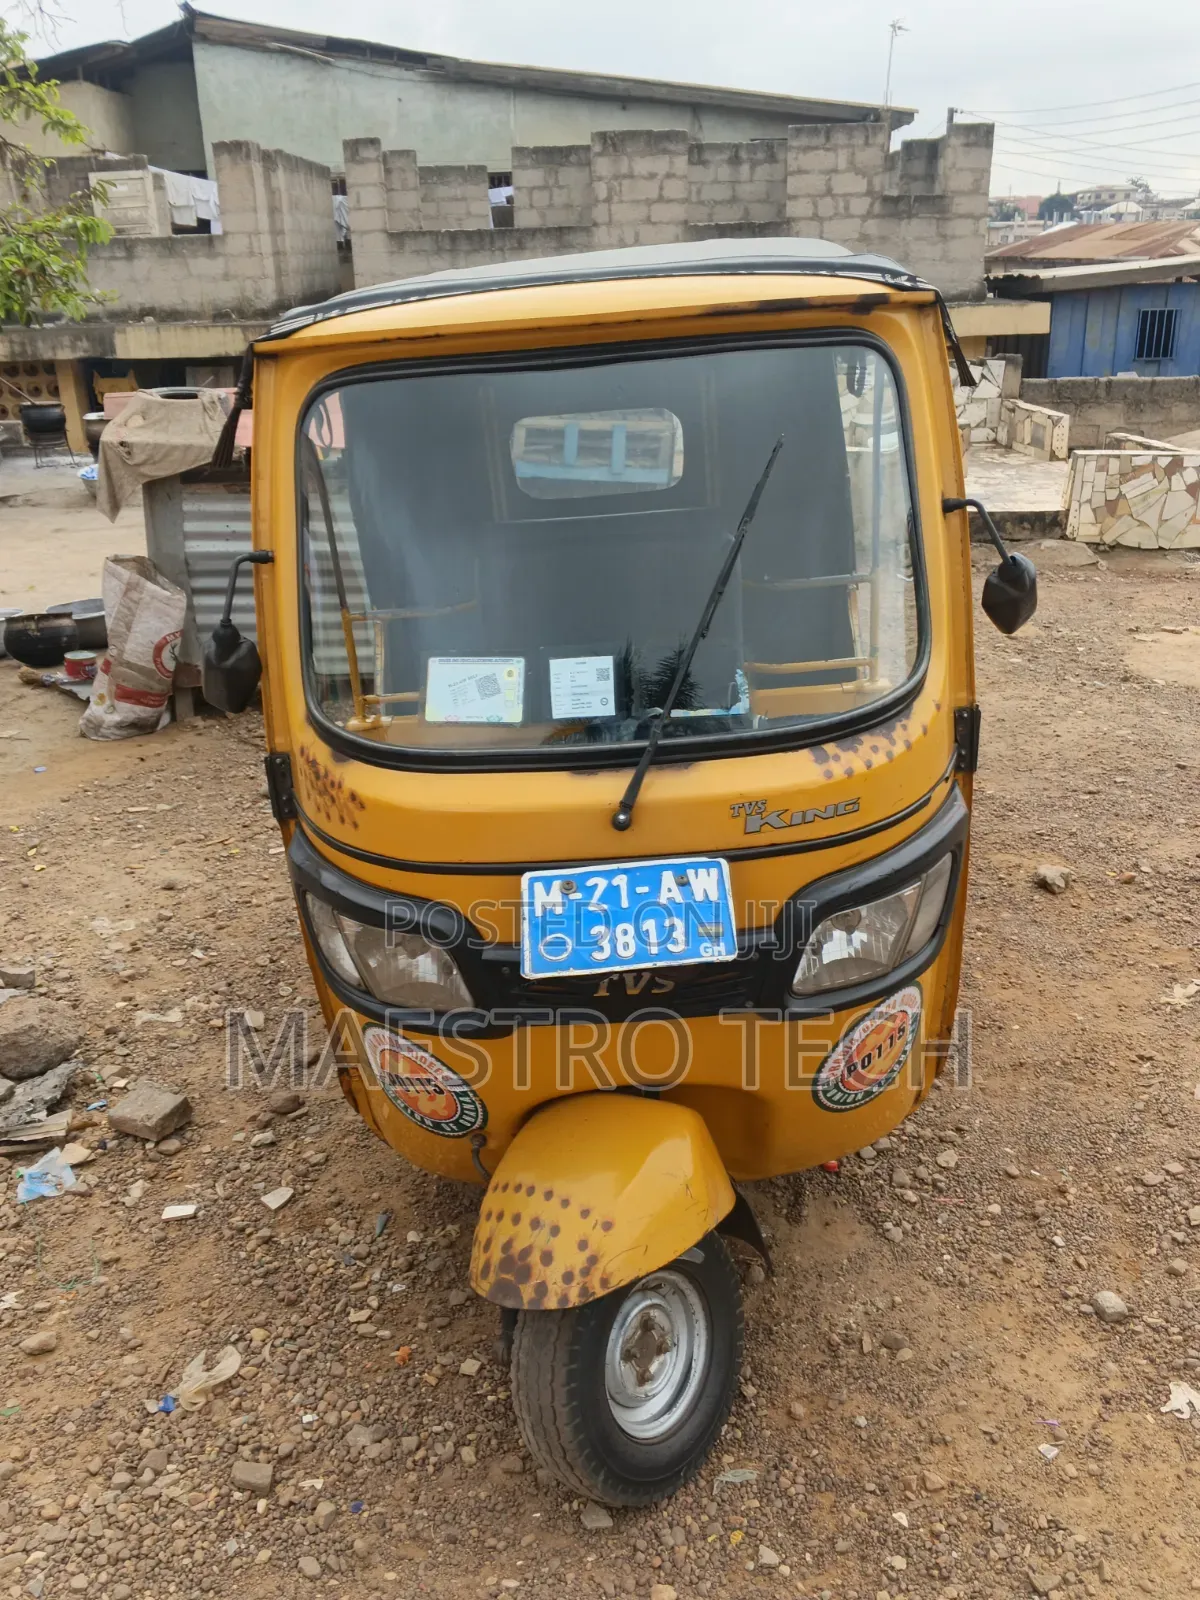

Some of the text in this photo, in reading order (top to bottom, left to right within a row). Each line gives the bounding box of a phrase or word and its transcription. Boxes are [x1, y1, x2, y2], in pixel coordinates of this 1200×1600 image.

[730, 799, 768, 818] TVS
[588, 916, 687, 962] 3813
[699, 942, 727, 957] GH
[592, 971, 676, 998] TVS
